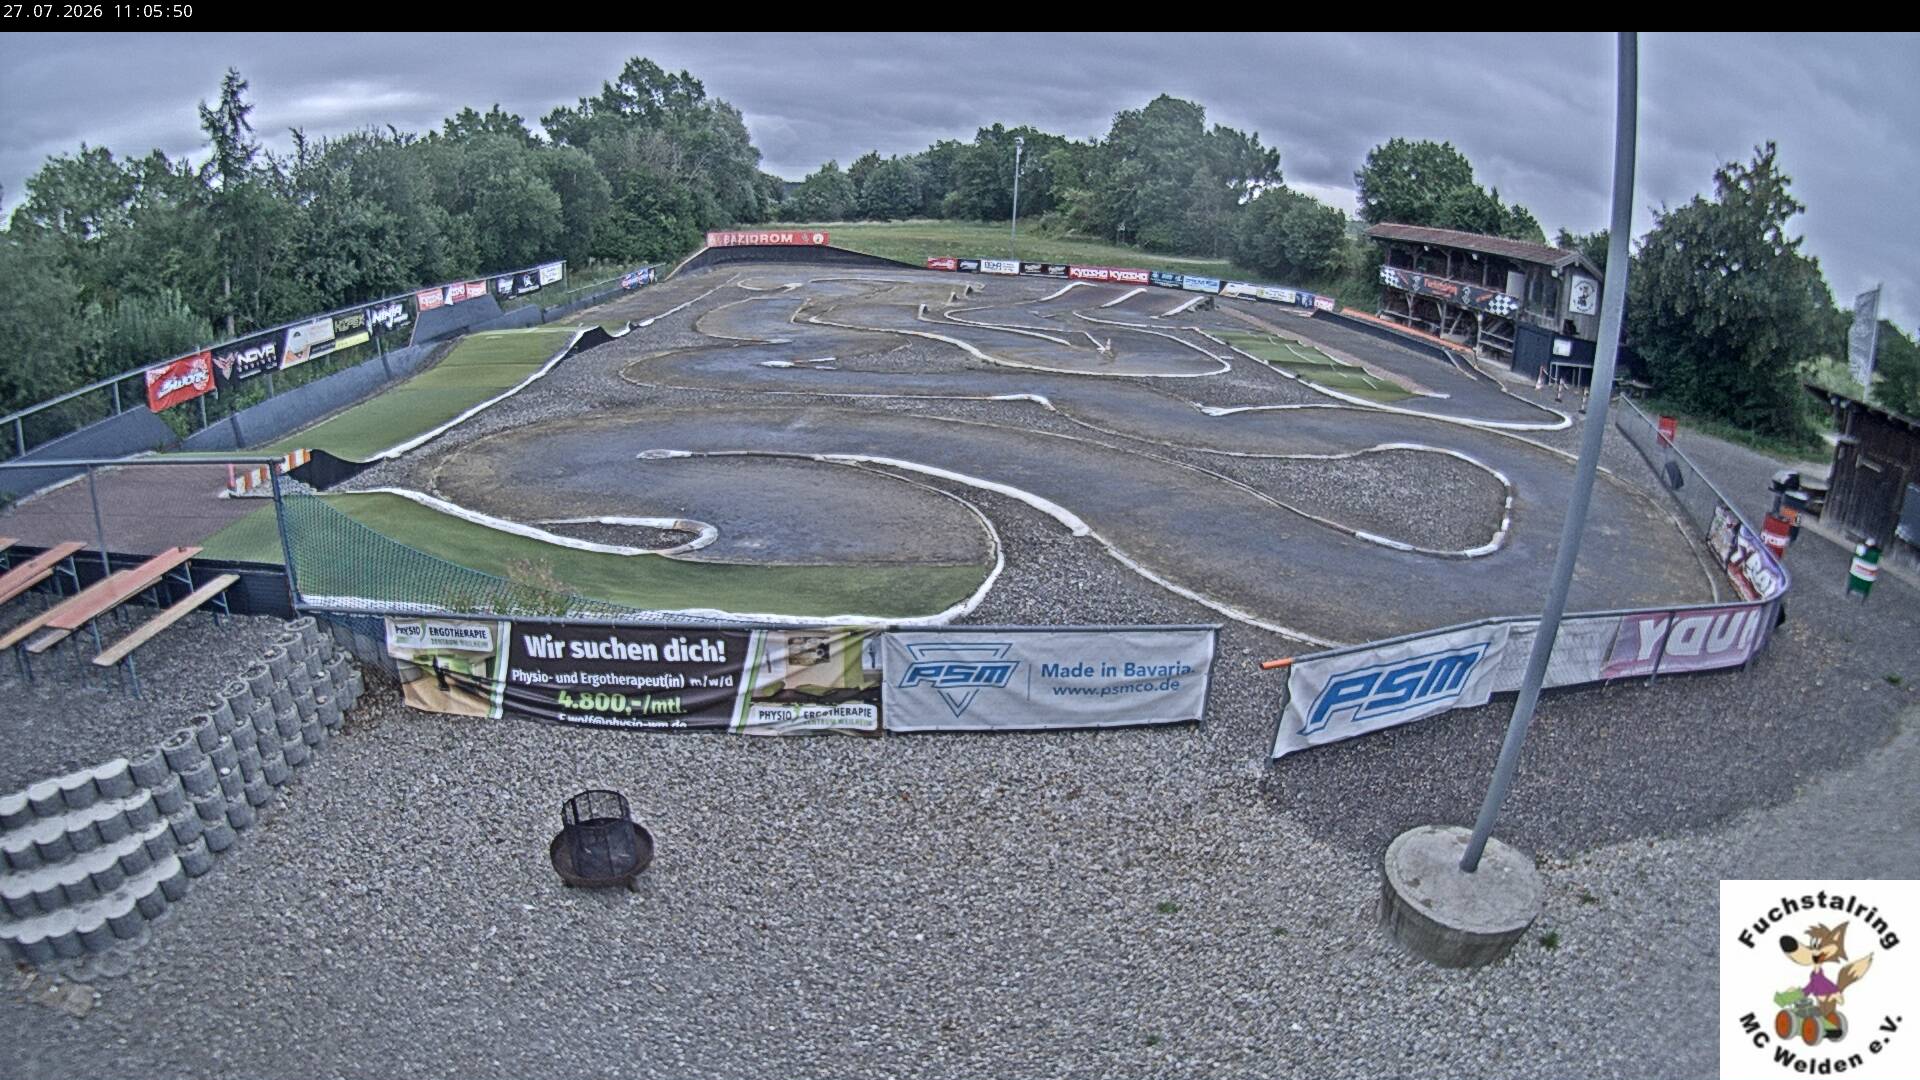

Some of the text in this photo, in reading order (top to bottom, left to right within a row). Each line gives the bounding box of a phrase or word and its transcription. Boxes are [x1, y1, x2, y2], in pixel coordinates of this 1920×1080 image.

[1070, 267, 1108, 281] KYOSHO
[1109, 269, 1148, 283] KYOSHO
[237, 344, 276, 366] NOVA
[394, 625, 421, 636] PHYSIO
[428, 626, 488, 640] ERGOTHERAPIE
[524, 634, 727, 663] Wir suchen dich!
[512, 668, 733, 689] Physio- und Ergotherapeut(in) m/w/d
[903, 663, 1016, 687] PSM
[1041, 662, 1094, 678] Made
[1101, 663, 1116, 677] in
[1053, 679, 1180, 697] www.psmco.de
[1304, 648, 1484, 729] PSM
[759, 710, 792, 721] PHYSIO
